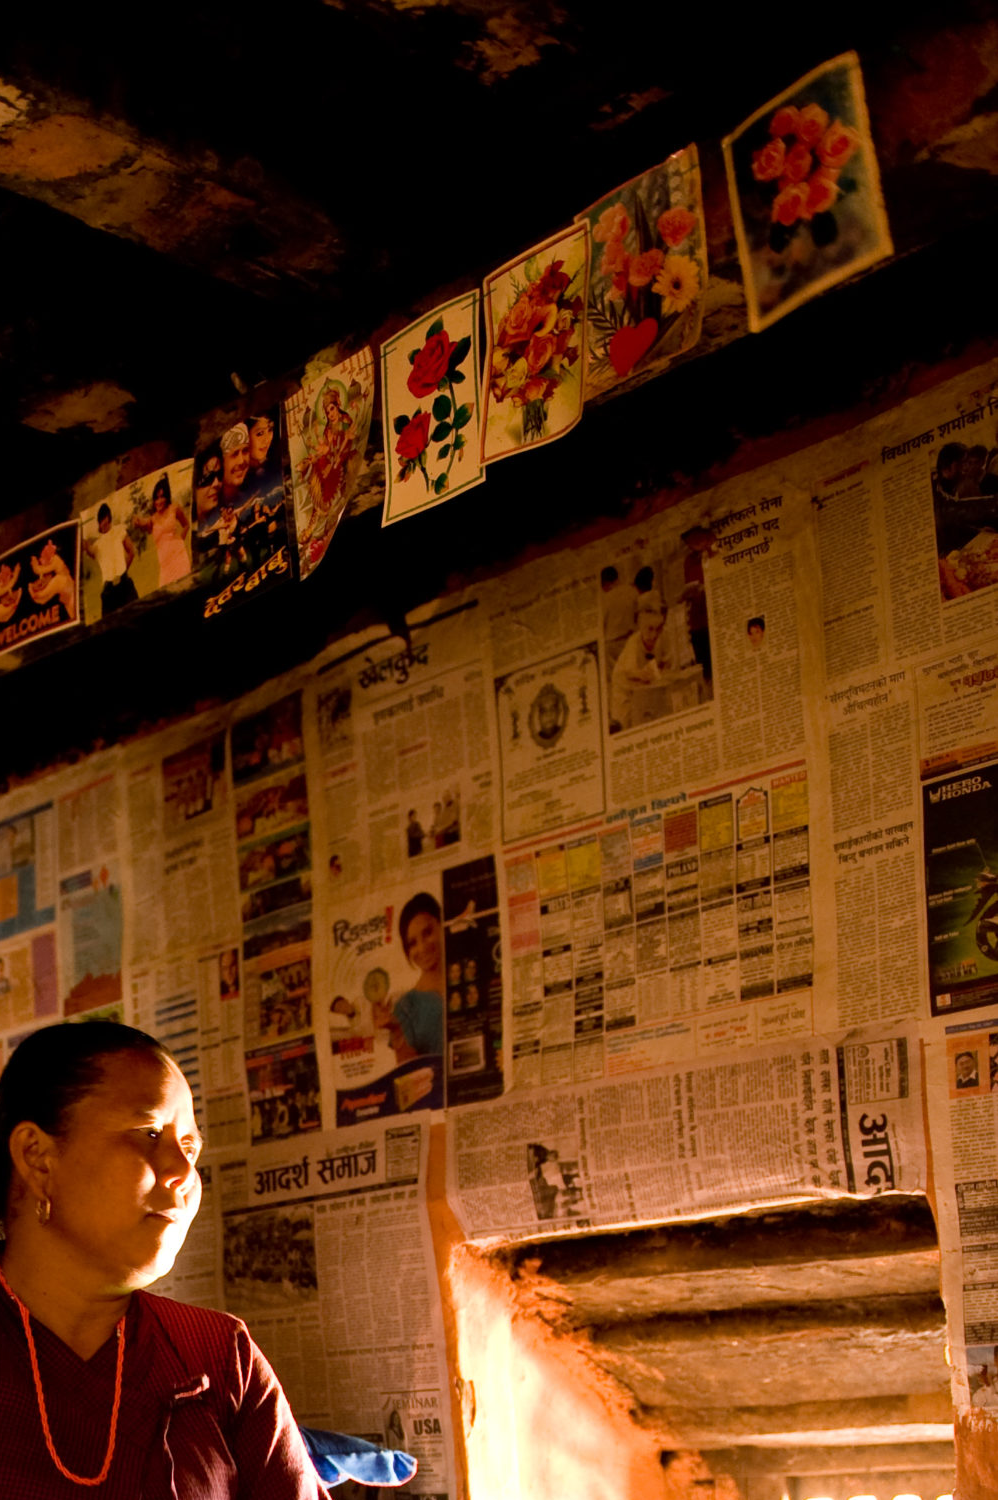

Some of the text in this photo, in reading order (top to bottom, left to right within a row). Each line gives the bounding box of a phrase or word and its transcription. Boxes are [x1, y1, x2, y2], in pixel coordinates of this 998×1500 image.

[881, 429, 934, 464] विधायक
[938, 405, 984, 440] शर्माको
[940, 776, 982, 794] HERO
[941, 781, 992, 802] HONDA
[254, 1149, 378, 1196] आदर्श समाज
[392, 1397, 438, 1410] SEMINAR
[414, 1418, 442, 1435] USA
